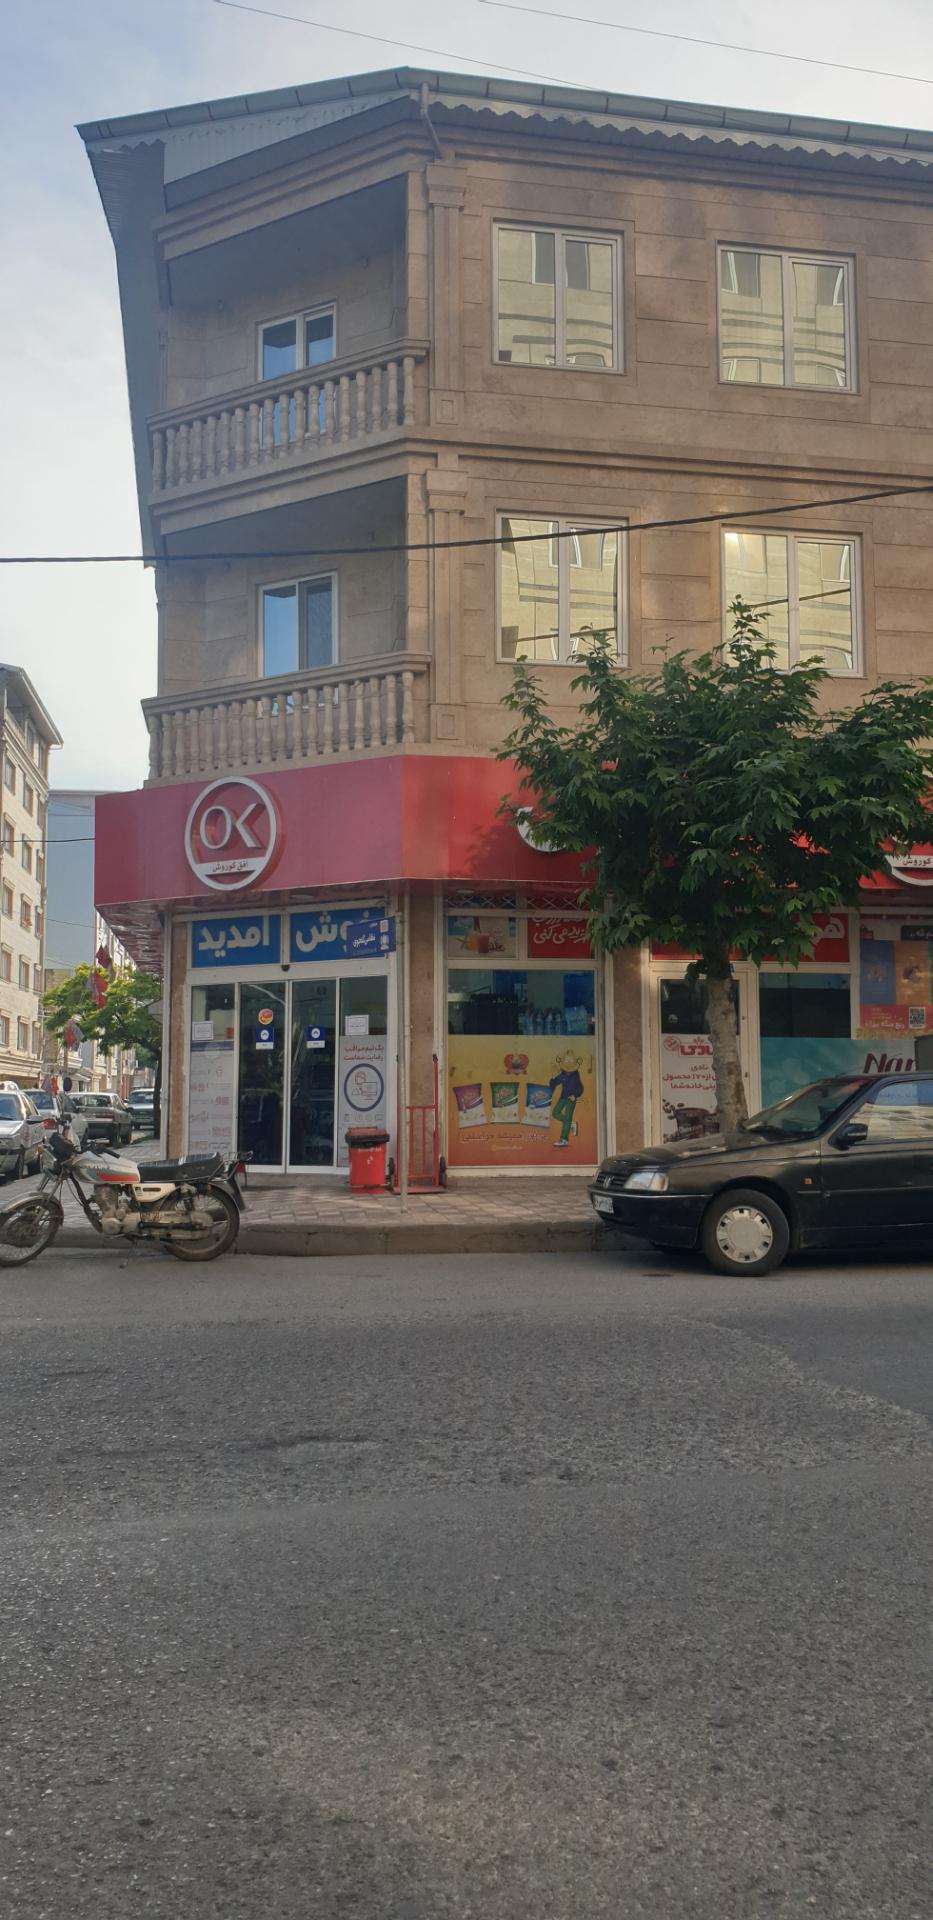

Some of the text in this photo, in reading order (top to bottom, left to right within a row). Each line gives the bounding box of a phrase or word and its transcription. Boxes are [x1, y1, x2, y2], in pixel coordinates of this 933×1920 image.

[201, 803, 257, 849] OK
[903, 857, 932, 867] کوروش
[212, 862, 236, 873] کوروش
[663, 1073, 691, 1081] محصول
